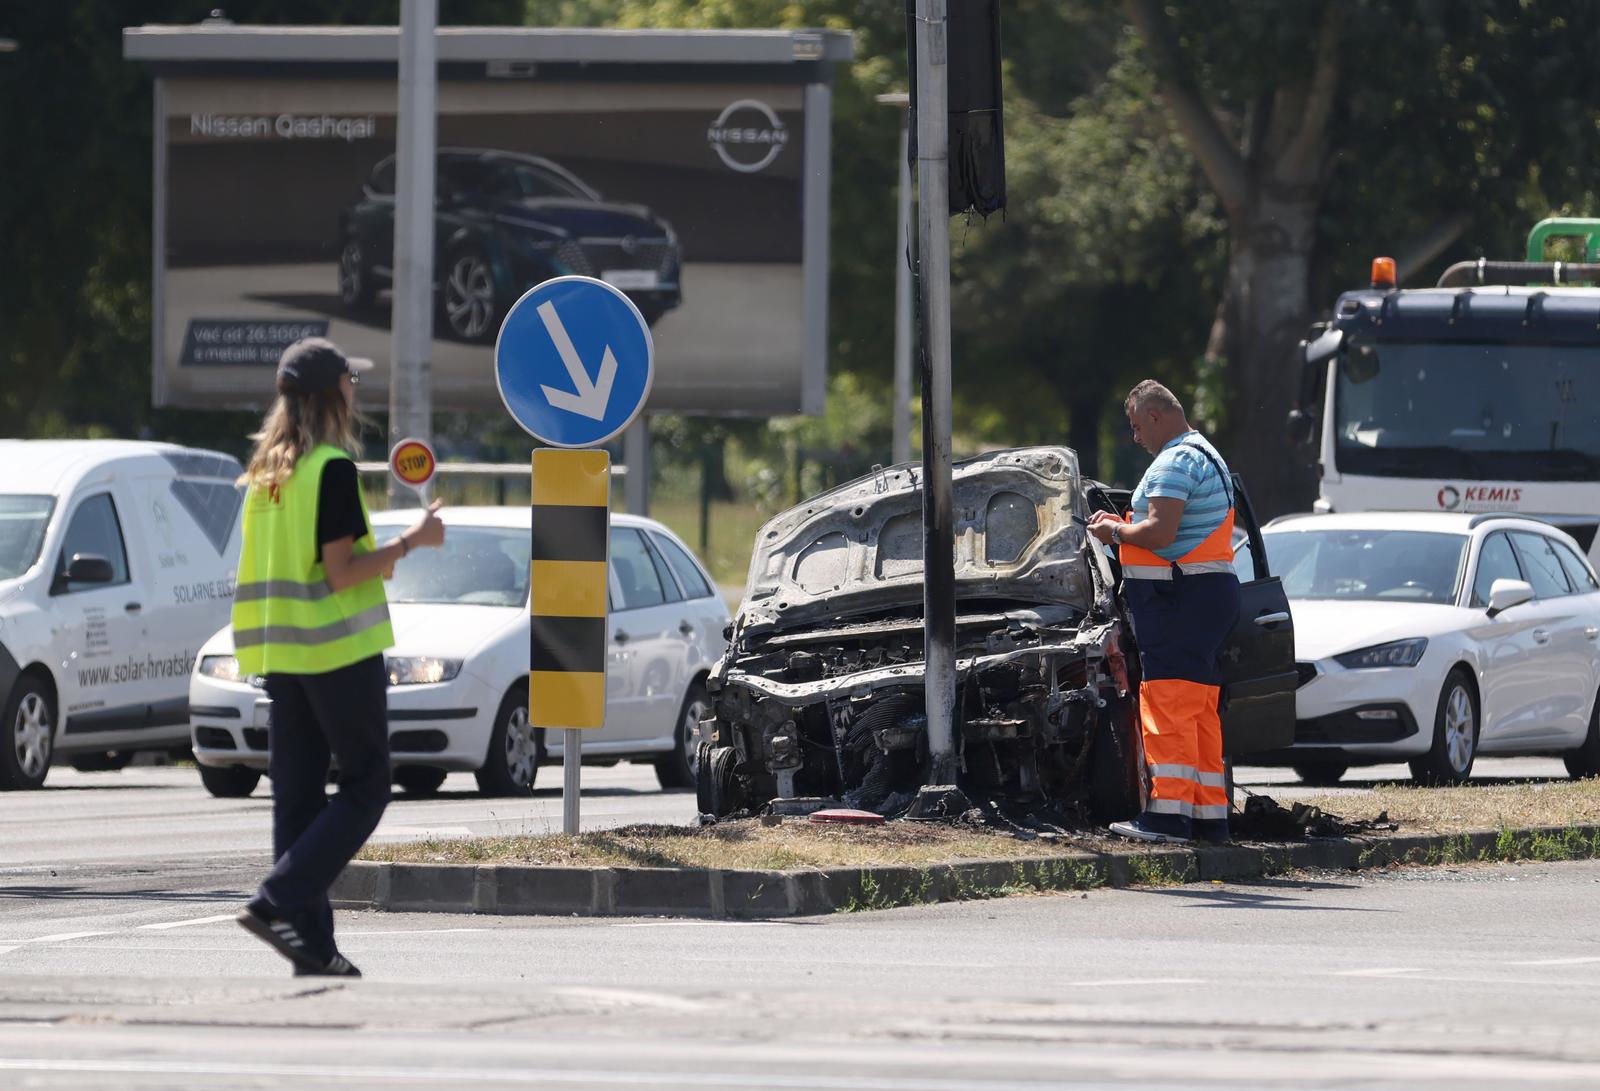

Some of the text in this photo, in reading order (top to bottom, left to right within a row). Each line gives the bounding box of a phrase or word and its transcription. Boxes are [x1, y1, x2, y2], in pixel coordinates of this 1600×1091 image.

[191, 112, 376, 142] Nissan Qashqai
[707, 127, 789, 143] NISSAN
[399, 454, 426, 472] STOP
[1465, 486, 1522, 502] KEMIS
[173, 581, 216, 603] SOLARNE
